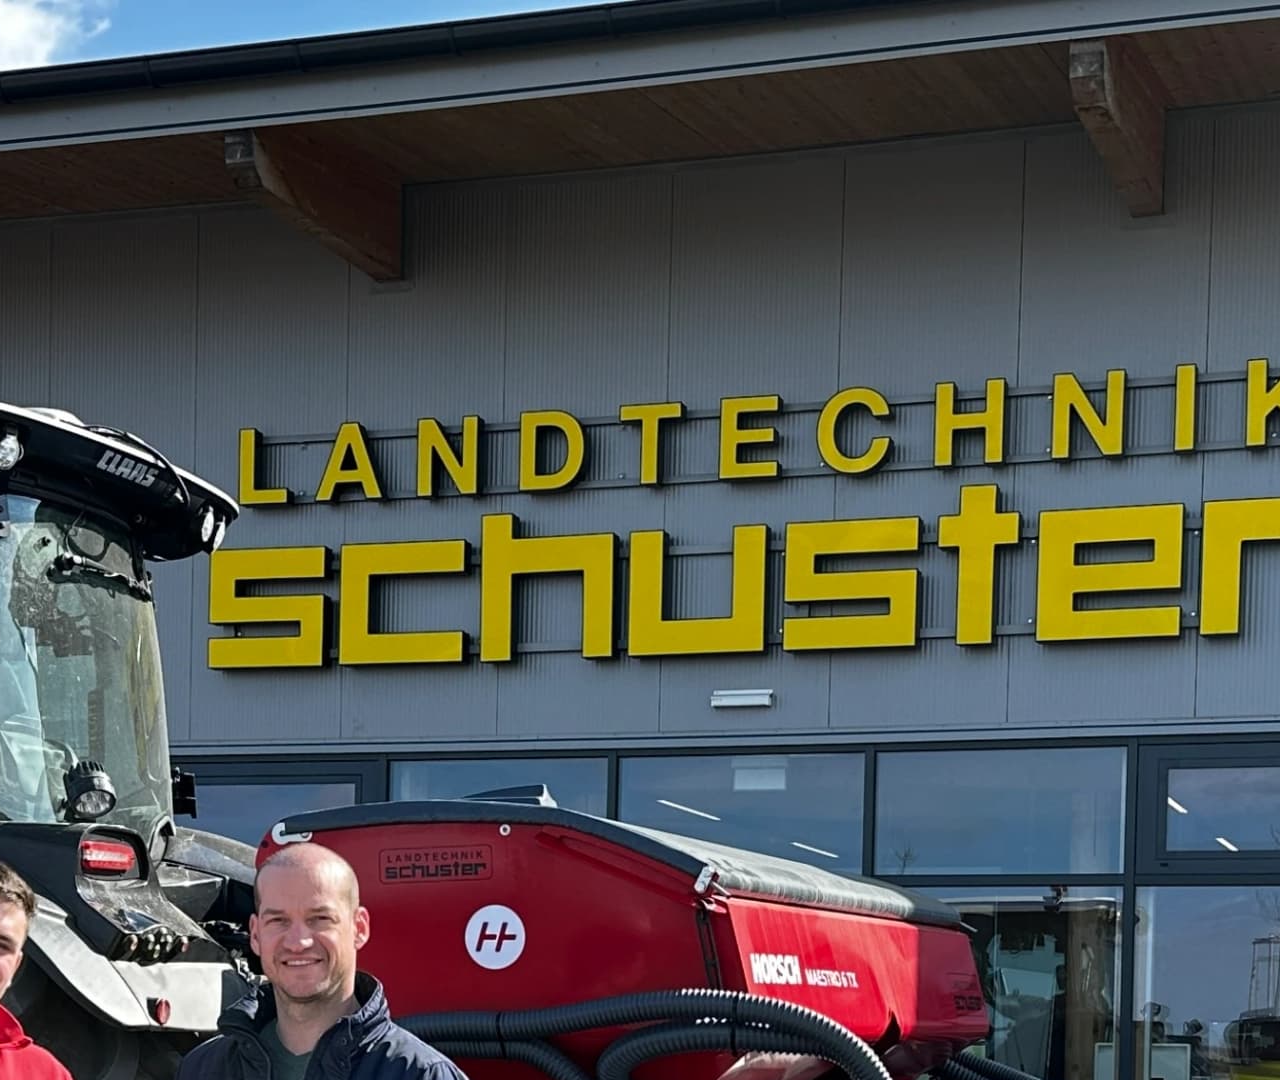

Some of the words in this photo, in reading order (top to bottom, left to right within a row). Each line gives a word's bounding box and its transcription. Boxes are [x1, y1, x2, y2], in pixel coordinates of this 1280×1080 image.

[96, 450, 160, 487] CLAAS
[387, 850, 484, 863] LANDTECHNIK
[385, 861, 487, 880] schuster
[749, 953, 803, 985] HORSCH
[805, 968, 841, 987] MAESTRO
